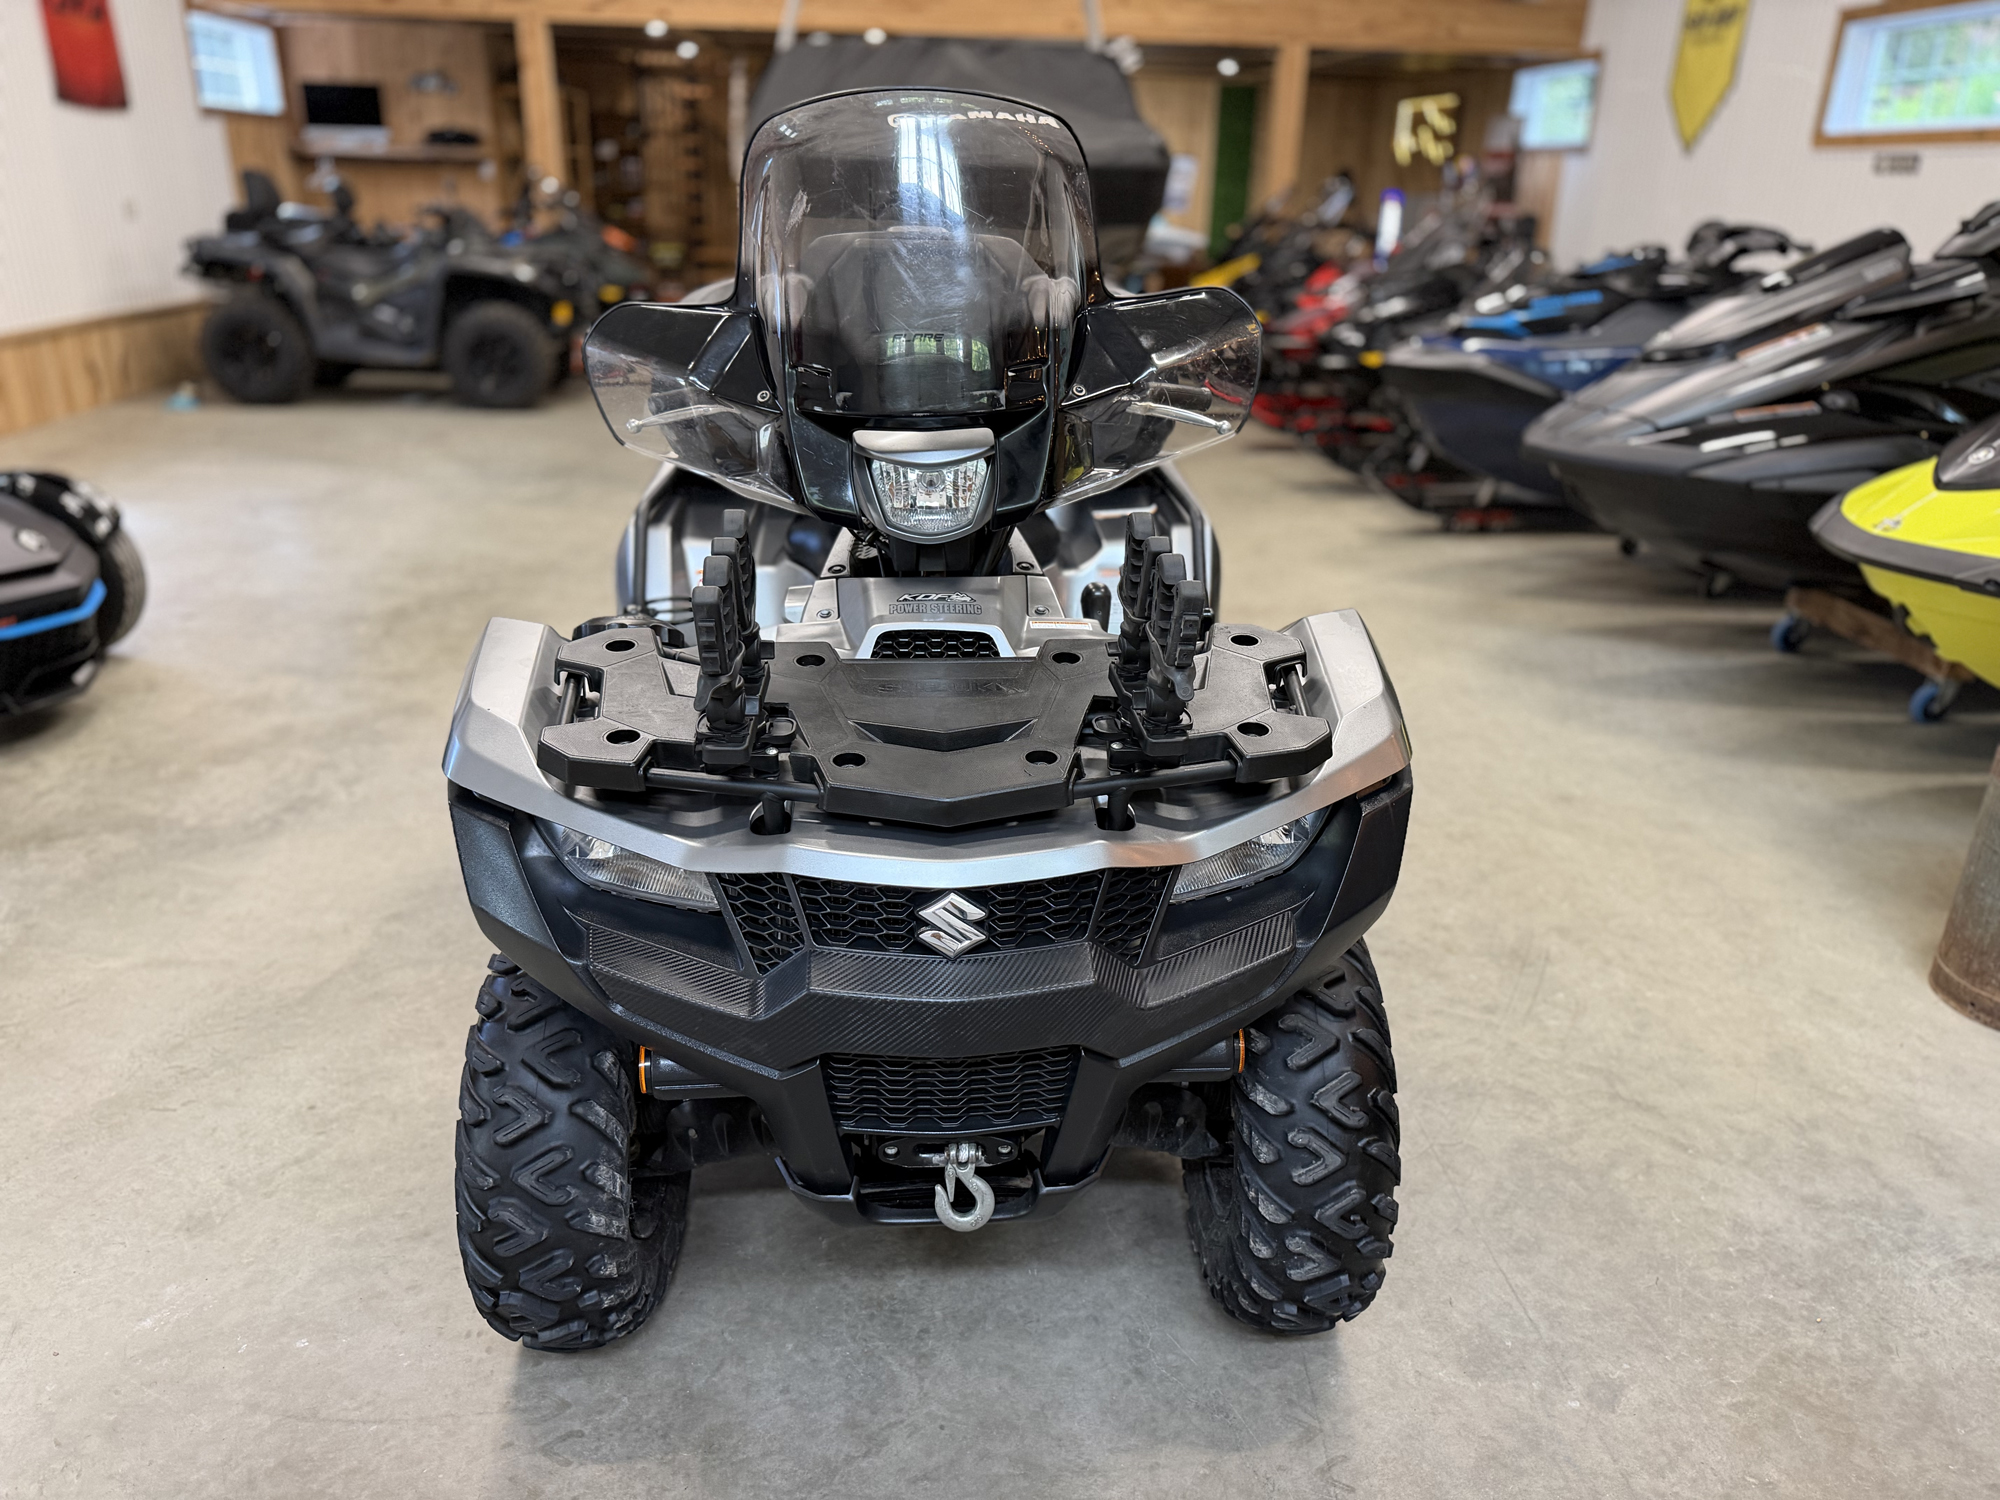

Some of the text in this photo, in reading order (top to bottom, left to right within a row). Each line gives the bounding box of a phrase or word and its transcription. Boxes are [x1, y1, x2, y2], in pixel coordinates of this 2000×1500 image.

[931, 111, 1061, 130] AMAHA
[889, 603, 982, 615] POWER STEERING
